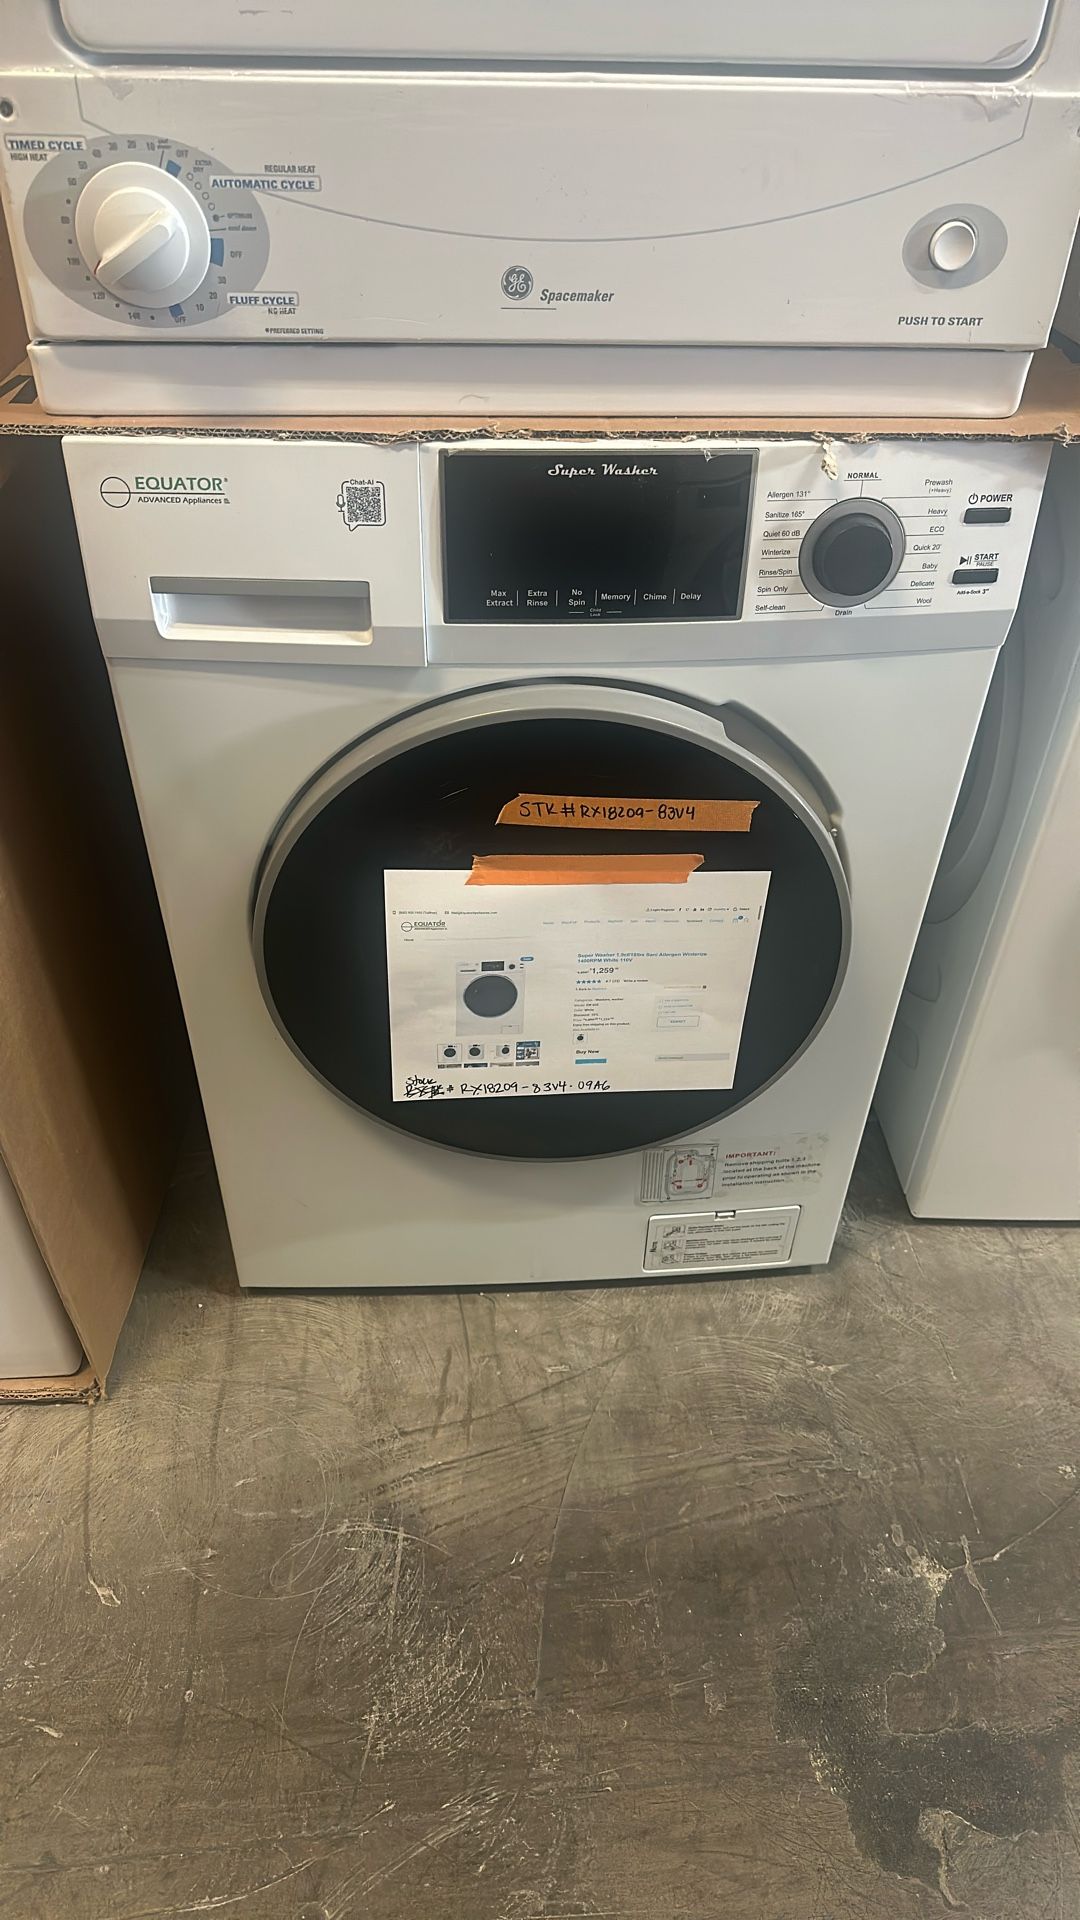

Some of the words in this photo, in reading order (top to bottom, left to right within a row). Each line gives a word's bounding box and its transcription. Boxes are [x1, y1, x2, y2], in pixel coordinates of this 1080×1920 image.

[8, 140, 45, 150] TIMED
[48, 140, 84, 151] CYCLE
[264, 164, 296, 173] REGULAR
[297, 165, 316, 174] HEAT
[211, 178, 278, 190] AUTOMATIC
[280, 179, 316, 190] CYCLE
[229, 295, 260, 306] FLUFF
[262, 296, 296, 306] CYCLE
[539, 288, 615, 305] Spacemaker
[195, 303, 205, 313] 10
[267, 307, 279, 316] NO
[279, 307, 296, 316] HEAT
[897, 316, 929, 326] PUSH
[930, 316, 946, 326] TO
[947, 317, 984, 327] START
[547, 463, 596, 478] Super
[601, 463, 659, 475] Washer
[924, 478, 954, 487] Prewash
[766, 491, 794, 500] Allergen
[979, 494, 1013, 503] POWER
[137, 496, 181, 504] ADVANCED
[182, 496, 223, 505] Appliances
[764, 511, 790, 519] Sanitize
[762, 530, 781, 538] Quiet
[912, 544, 931, 552] Quick
[974, 553, 999, 561] START
[921, 563, 938, 571] Baby
[758, 568, 793, 577] Rinse/Spin
[910, 580, 935, 588] Delicate
[527, 589, 548, 597] Extra
[571, 588, 583, 596] No
[757, 586, 772, 594] Spin
[773, 585, 788, 593] Only
[600, 593, 631, 602] Memory
[680, 592, 702, 600] Delay
[486, 599, 514, 607] Extract
[526, 599, 549, 607] Rinse
[568, 598, 586, 607] Spin
[754, 604, 786, 612] Self-clean
[834, 609, 853, 617] Drain
[519, 801, 558, 818] STK
[560, 803, 575, 817] #
